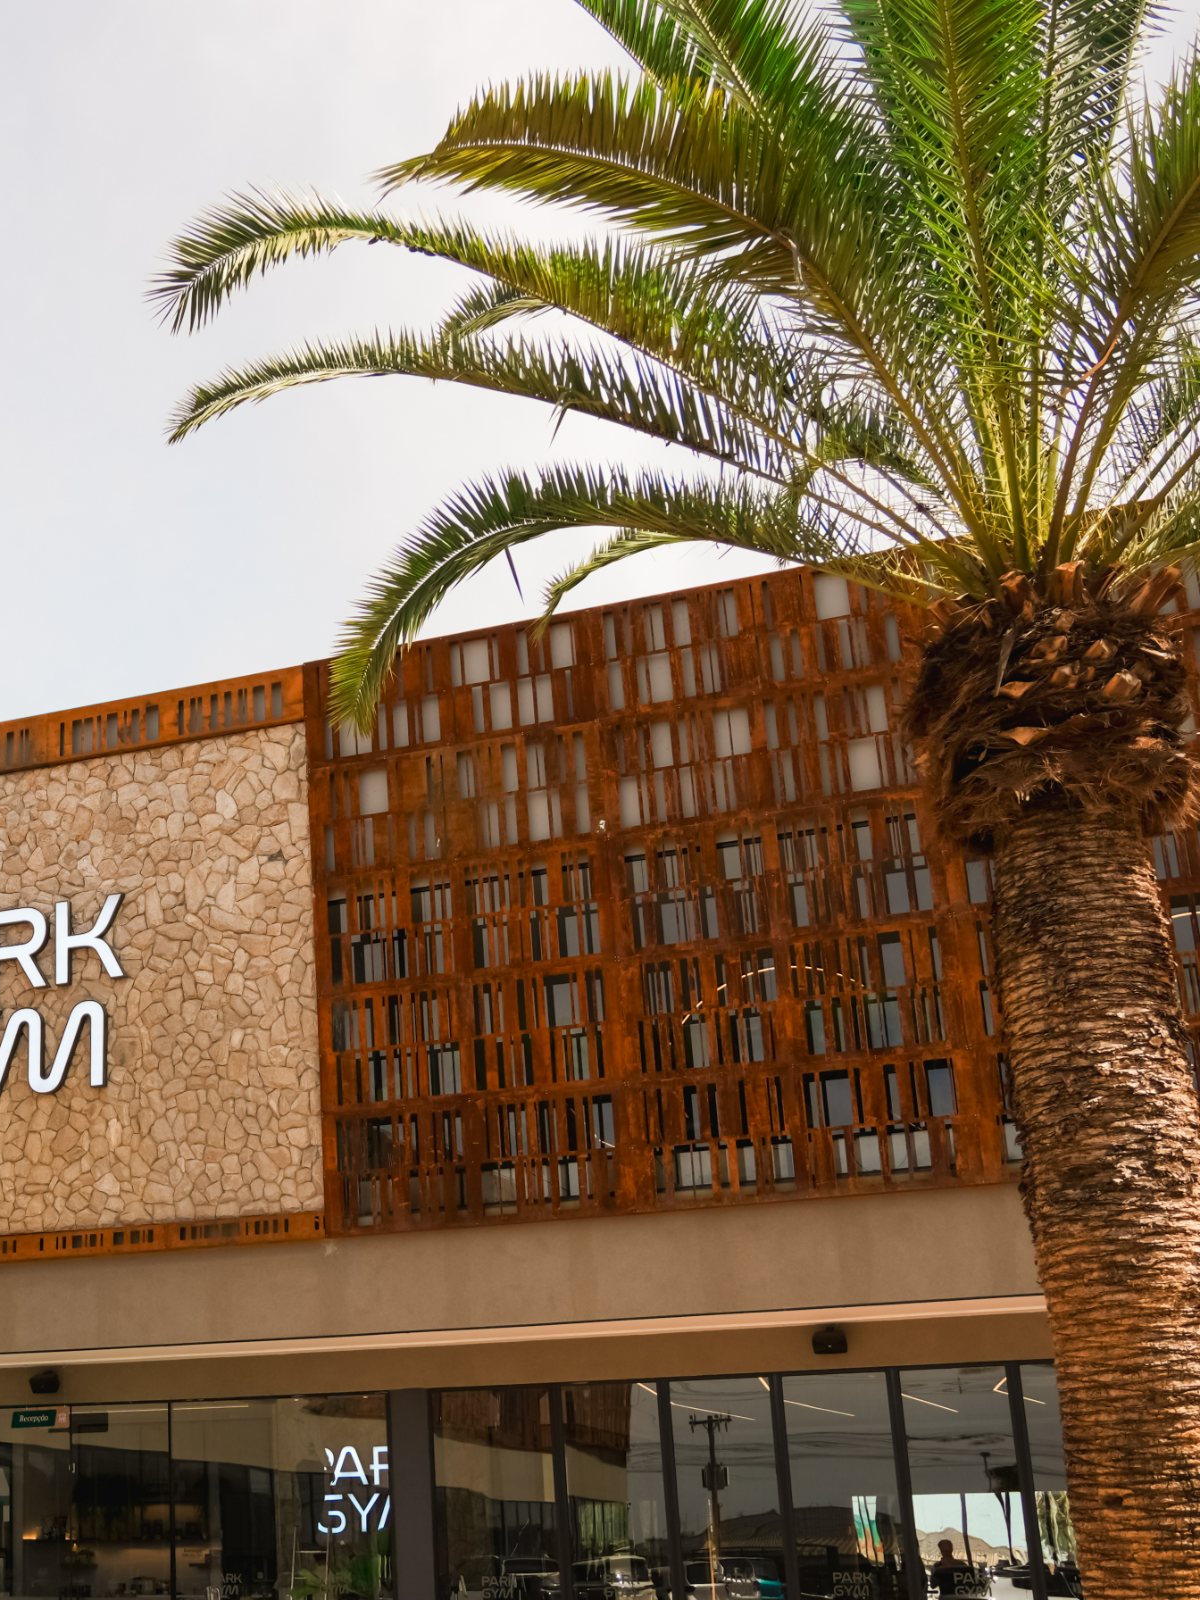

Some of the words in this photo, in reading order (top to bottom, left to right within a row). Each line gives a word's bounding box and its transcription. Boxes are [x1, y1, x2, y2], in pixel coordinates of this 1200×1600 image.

[833, 1572, 874, 1584] PARK
[482, 1588, 513, 1599] GYM
[834, 1585, 870, 1598] GYM
